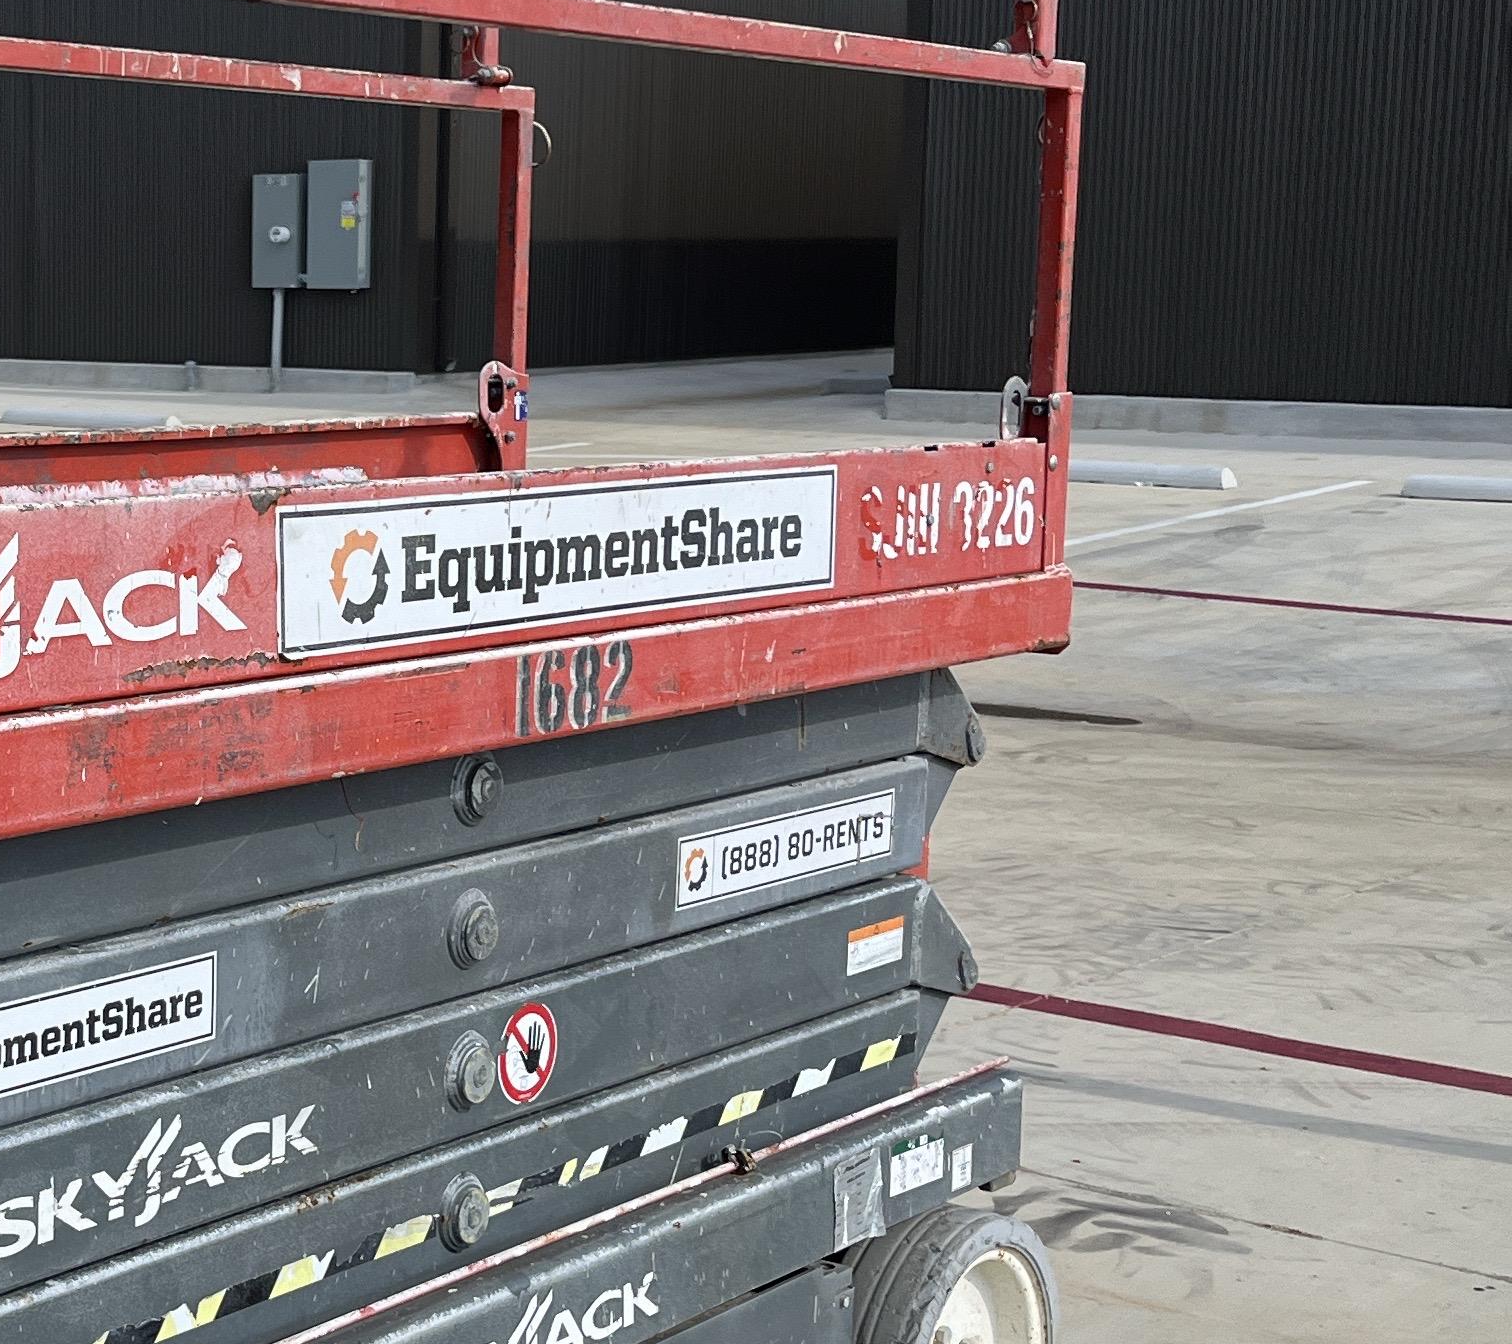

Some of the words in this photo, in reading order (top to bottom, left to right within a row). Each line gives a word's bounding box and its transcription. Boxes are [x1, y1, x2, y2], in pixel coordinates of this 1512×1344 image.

[400, 507, 804, 614] EquipmentShare
[515, 639, 633, 737] 1682
[720, 838, 781, 881] (888)
[786, 811, 885, 862] 80-RENTS
